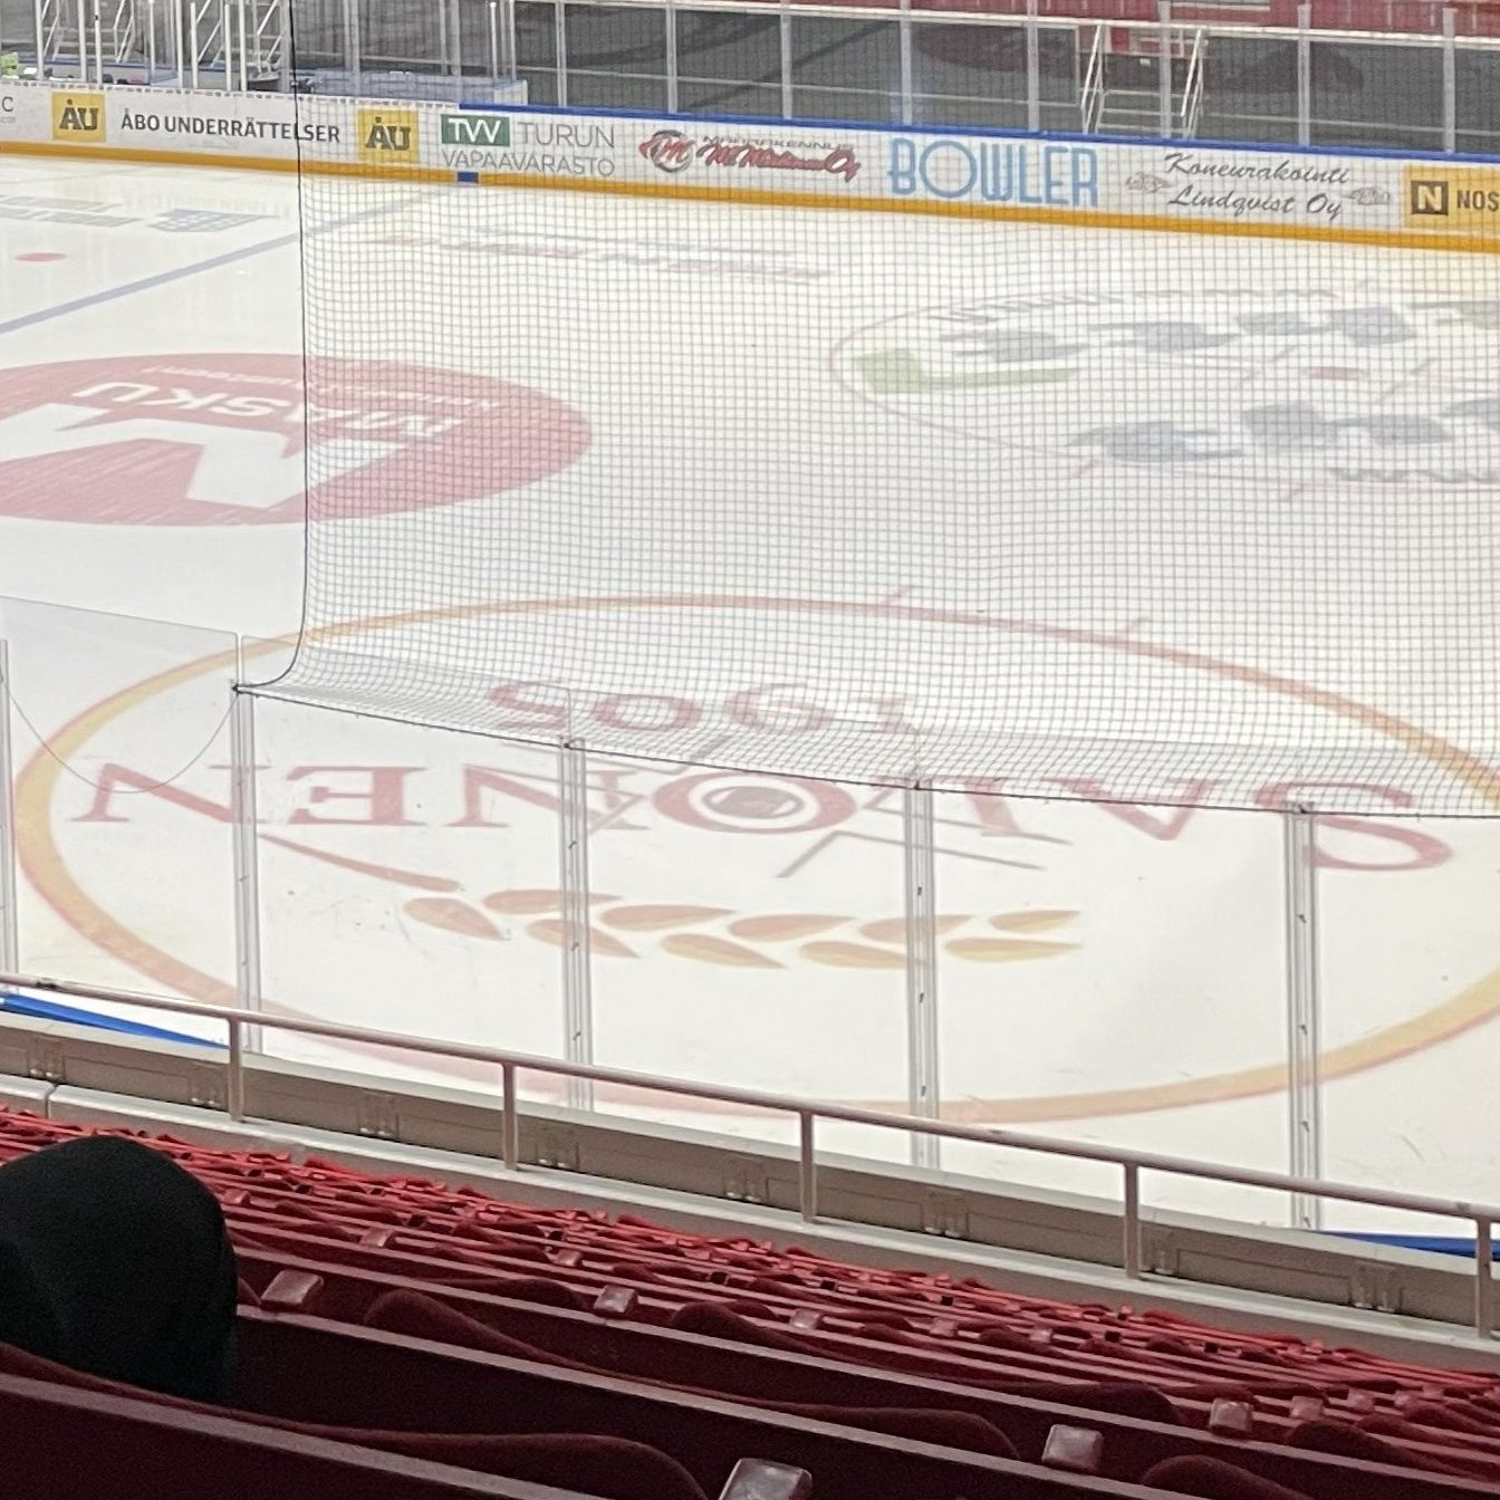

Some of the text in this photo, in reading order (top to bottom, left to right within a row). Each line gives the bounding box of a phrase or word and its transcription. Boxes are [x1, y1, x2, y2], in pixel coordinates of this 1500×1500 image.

[120, 108, 340, 144] ÅBO UNDERRÄTTELSER
[517, 121, 615, 149] TURUN
[440, 149, 615, 177] VAPAAVARASTO
[887, 137, 1098, 207] BOWLER
[1163, 151, 1350, 184] Koneurakointi
[1167, 184, 1344, 222] Lindqvist Oy
